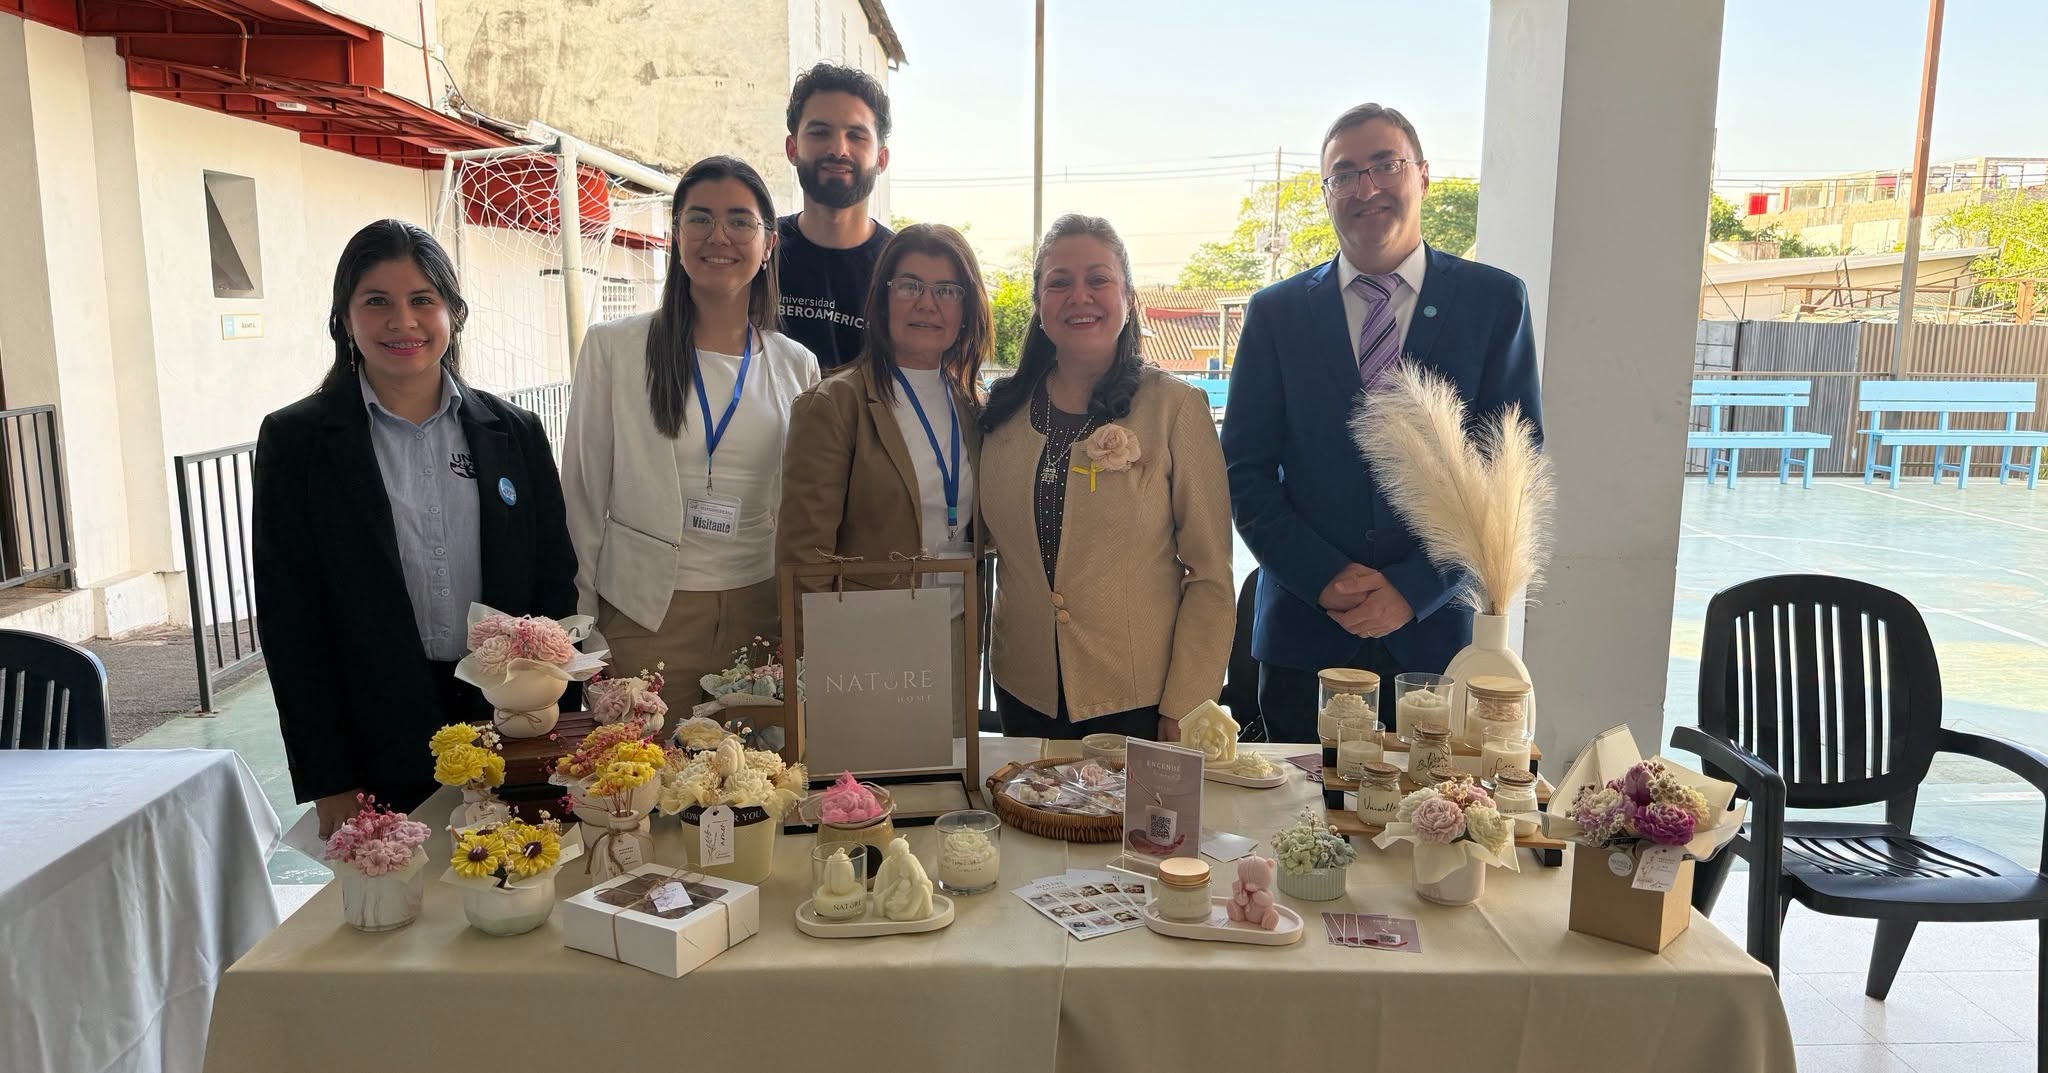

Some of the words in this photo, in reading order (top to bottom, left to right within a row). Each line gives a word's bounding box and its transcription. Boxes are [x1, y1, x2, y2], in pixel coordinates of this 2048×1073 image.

[779, 305, 865, 330] BEROAMERIC
[692, 516, 731, 534] Visitante
[825, 668, 933, 693] NATURE
[742, 809, 763, 821] YOU
